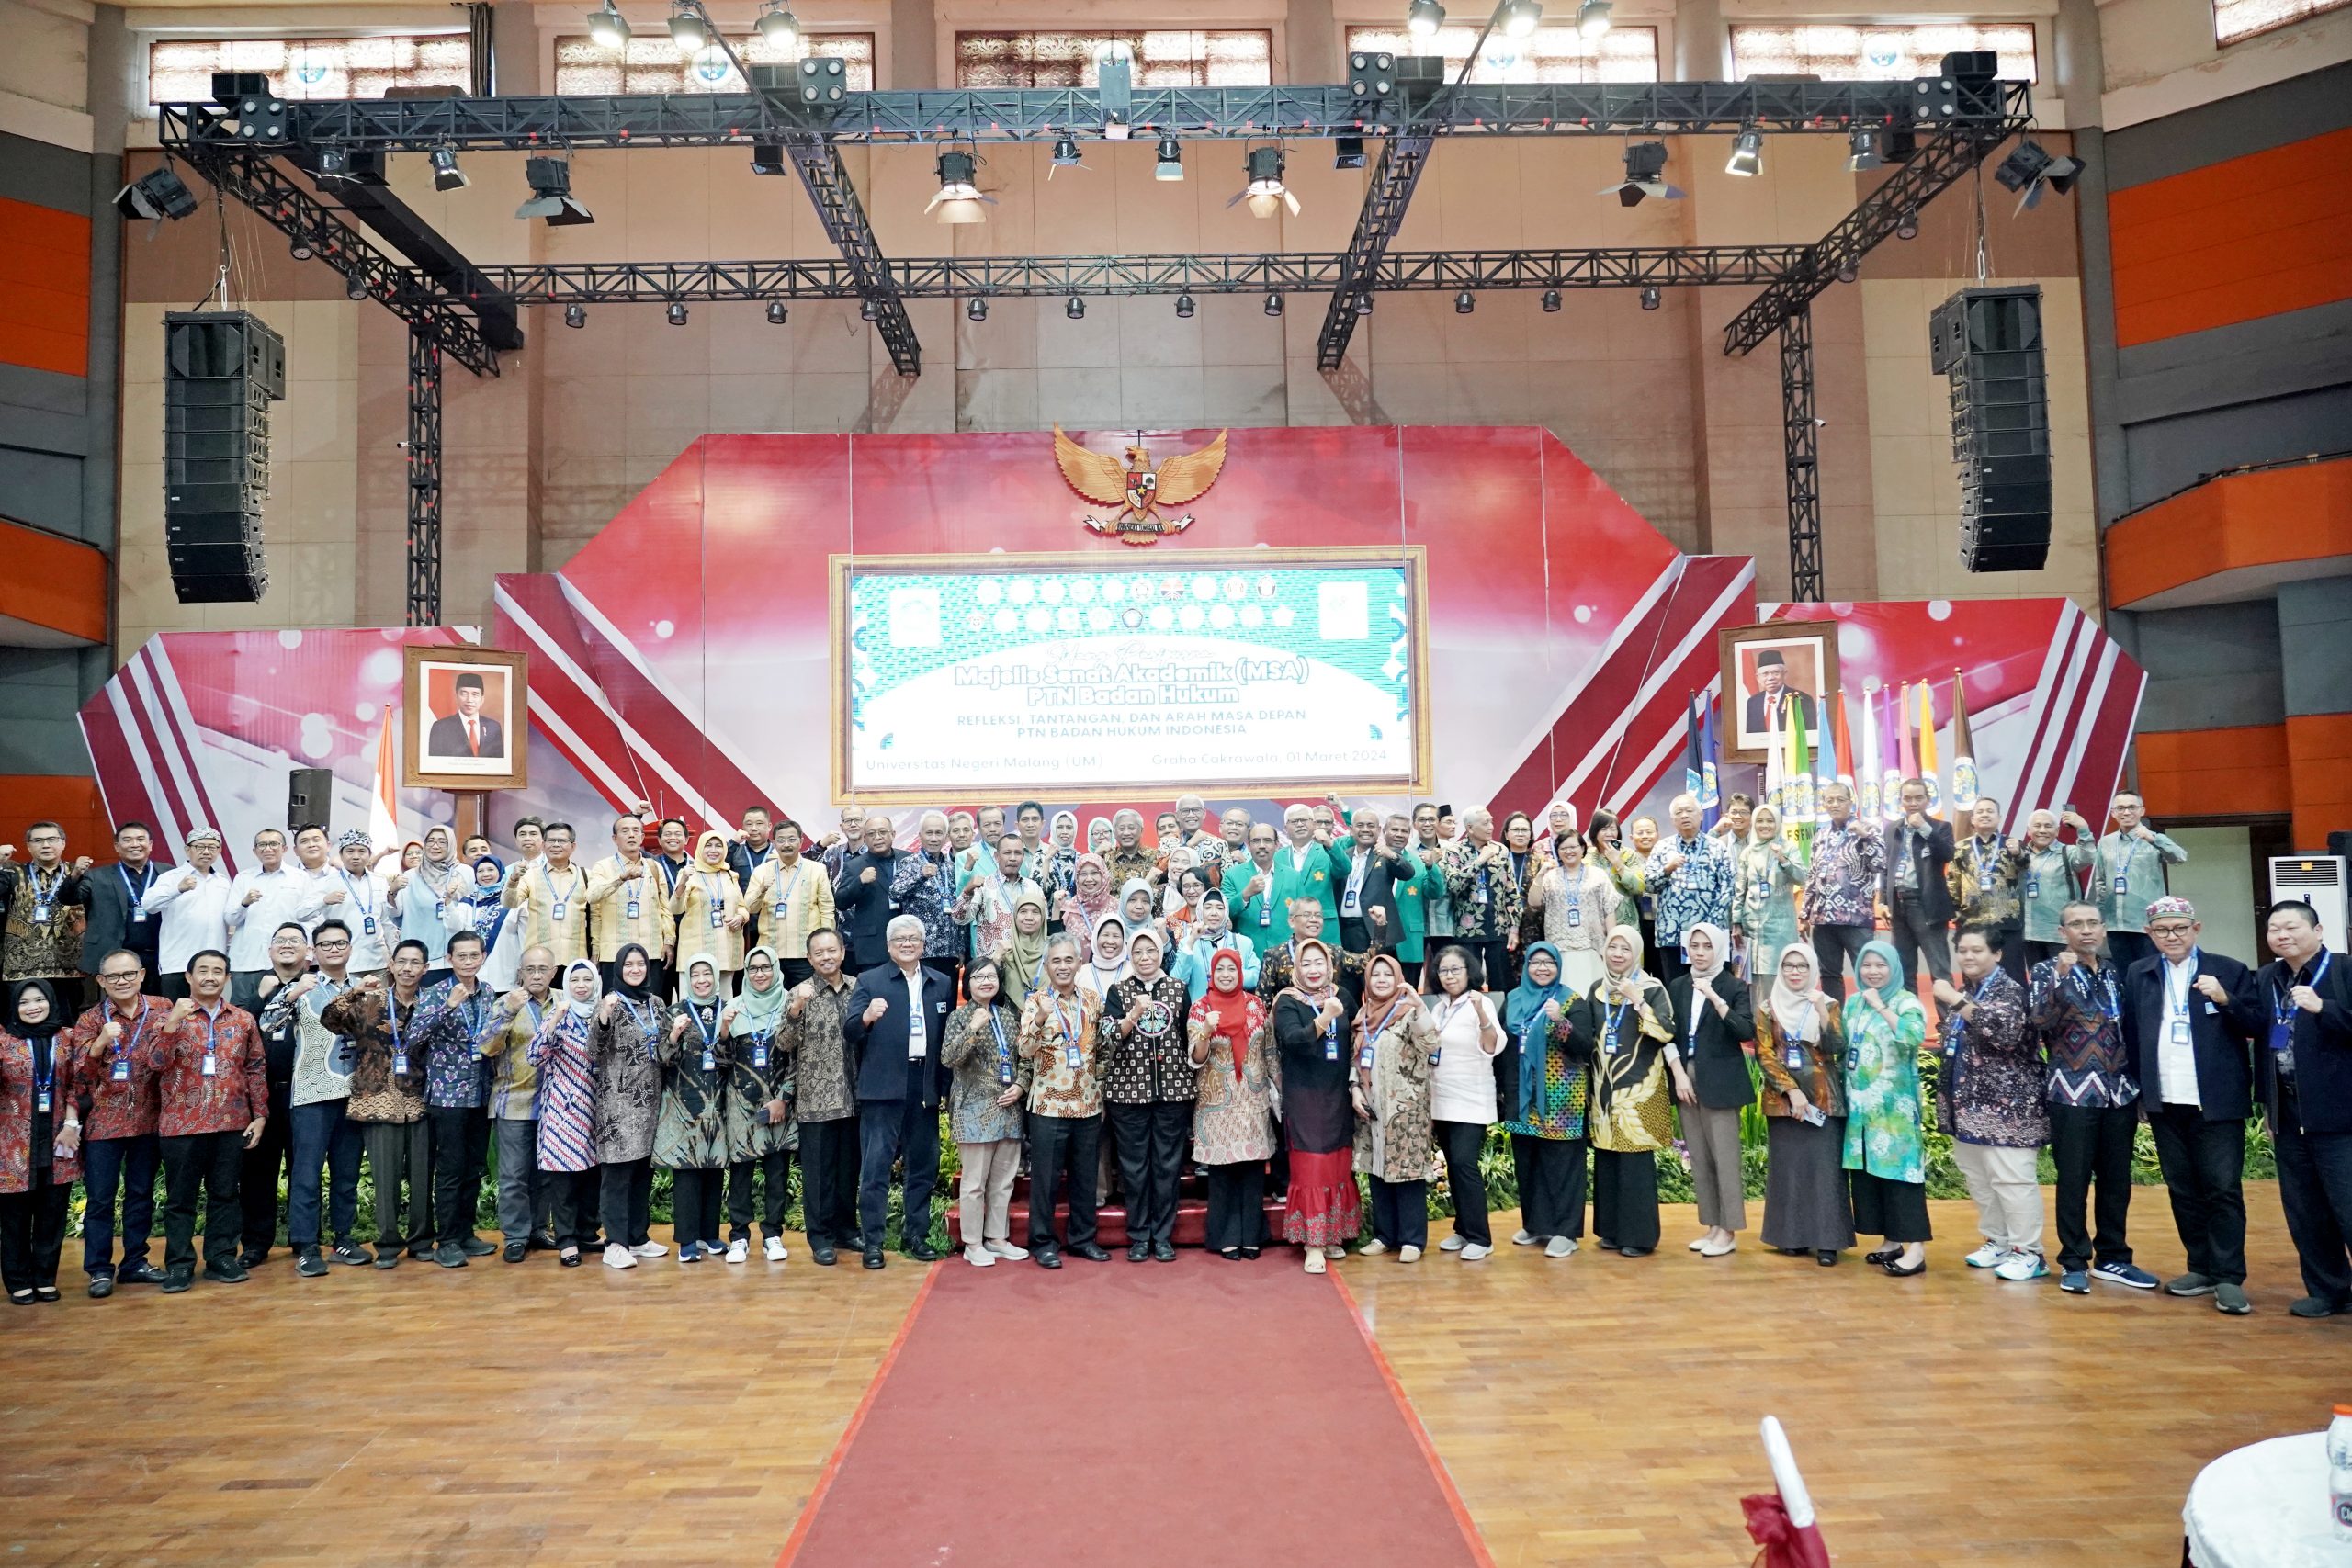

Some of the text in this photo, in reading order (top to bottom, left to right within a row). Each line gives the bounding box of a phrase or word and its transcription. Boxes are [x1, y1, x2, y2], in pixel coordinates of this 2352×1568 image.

[956, 656, 1309, 691] Majelis Senat Akademik (MSA)
[1027, 683, 1240, 706] PTN Badan Hukum
[957, 710, 1306, 727] REFLEKSI, TANTANGAN, DAN ARAH MASA DEPAN
[1017, 725, 1247, 739] PTN BADAN HUKUM INDONESIA
[866, 753, 1102, 772] Universitas Negeri Malang (UM)
[1152, 750, 1388, 765] Graha Cakrawala, 01 Maret 2024
